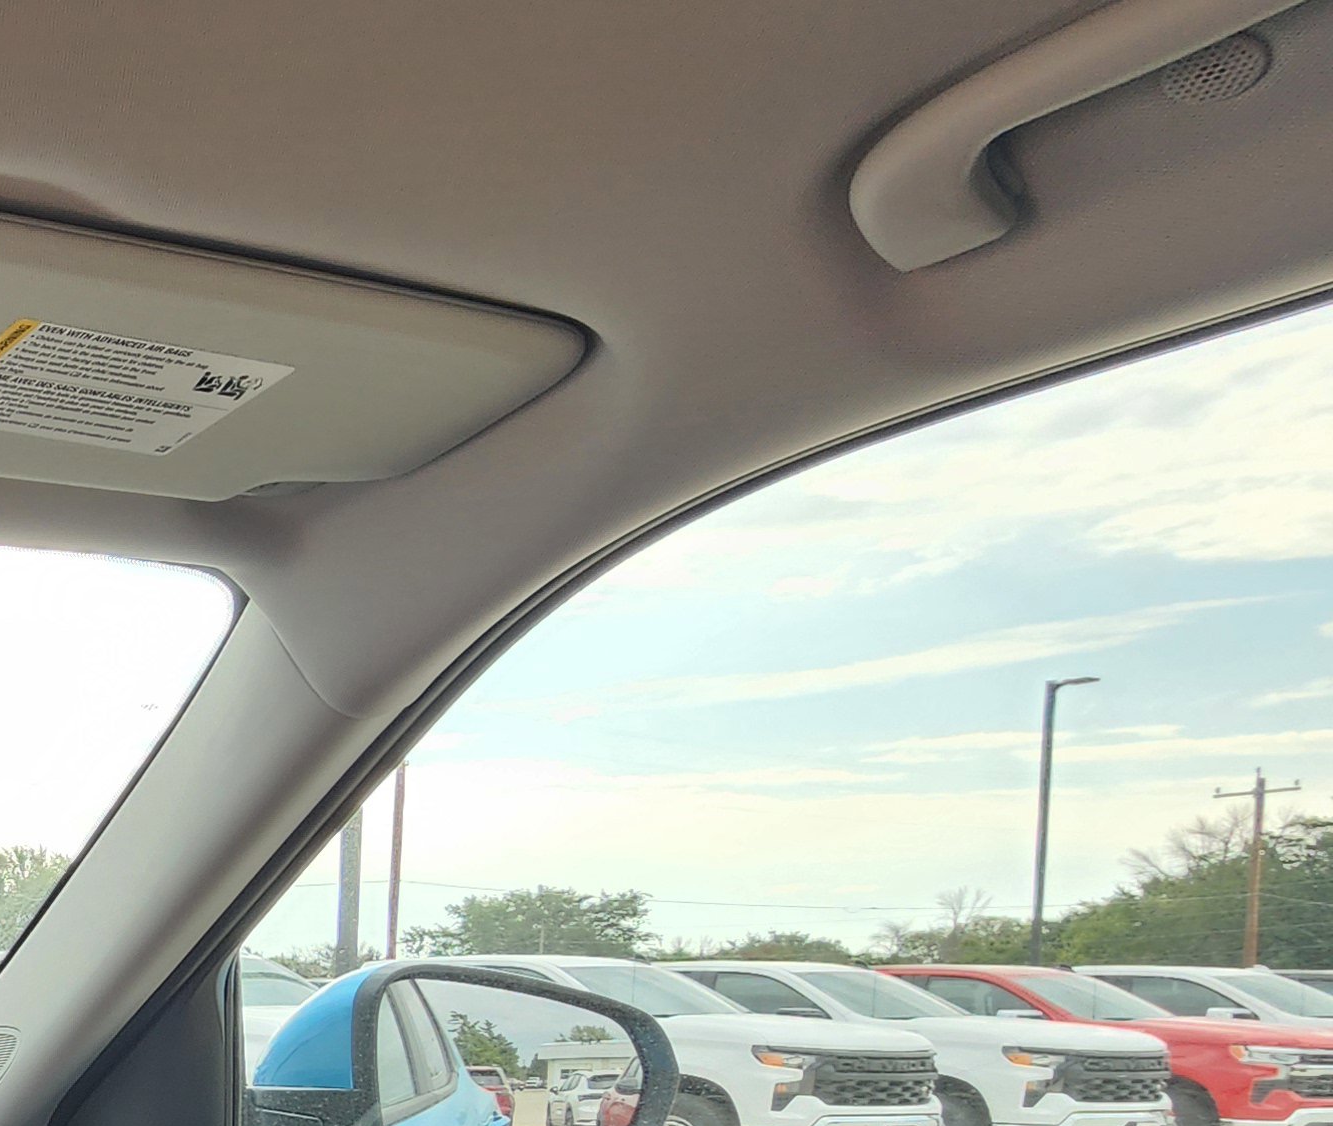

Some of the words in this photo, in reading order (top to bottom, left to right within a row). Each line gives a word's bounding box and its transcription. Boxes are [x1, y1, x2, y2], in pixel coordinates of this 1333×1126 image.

[38, 324, 66, 336] EVEN
[67, 329, 92, 340] WITH
[93, 333, 147, 350] ADVANCED
[147, 343, 165, 353] AIR
[164, 346, 194, 358] BAGS
[36, 380, 53, 389] DES
[54, 383, 78, 393] SACS
